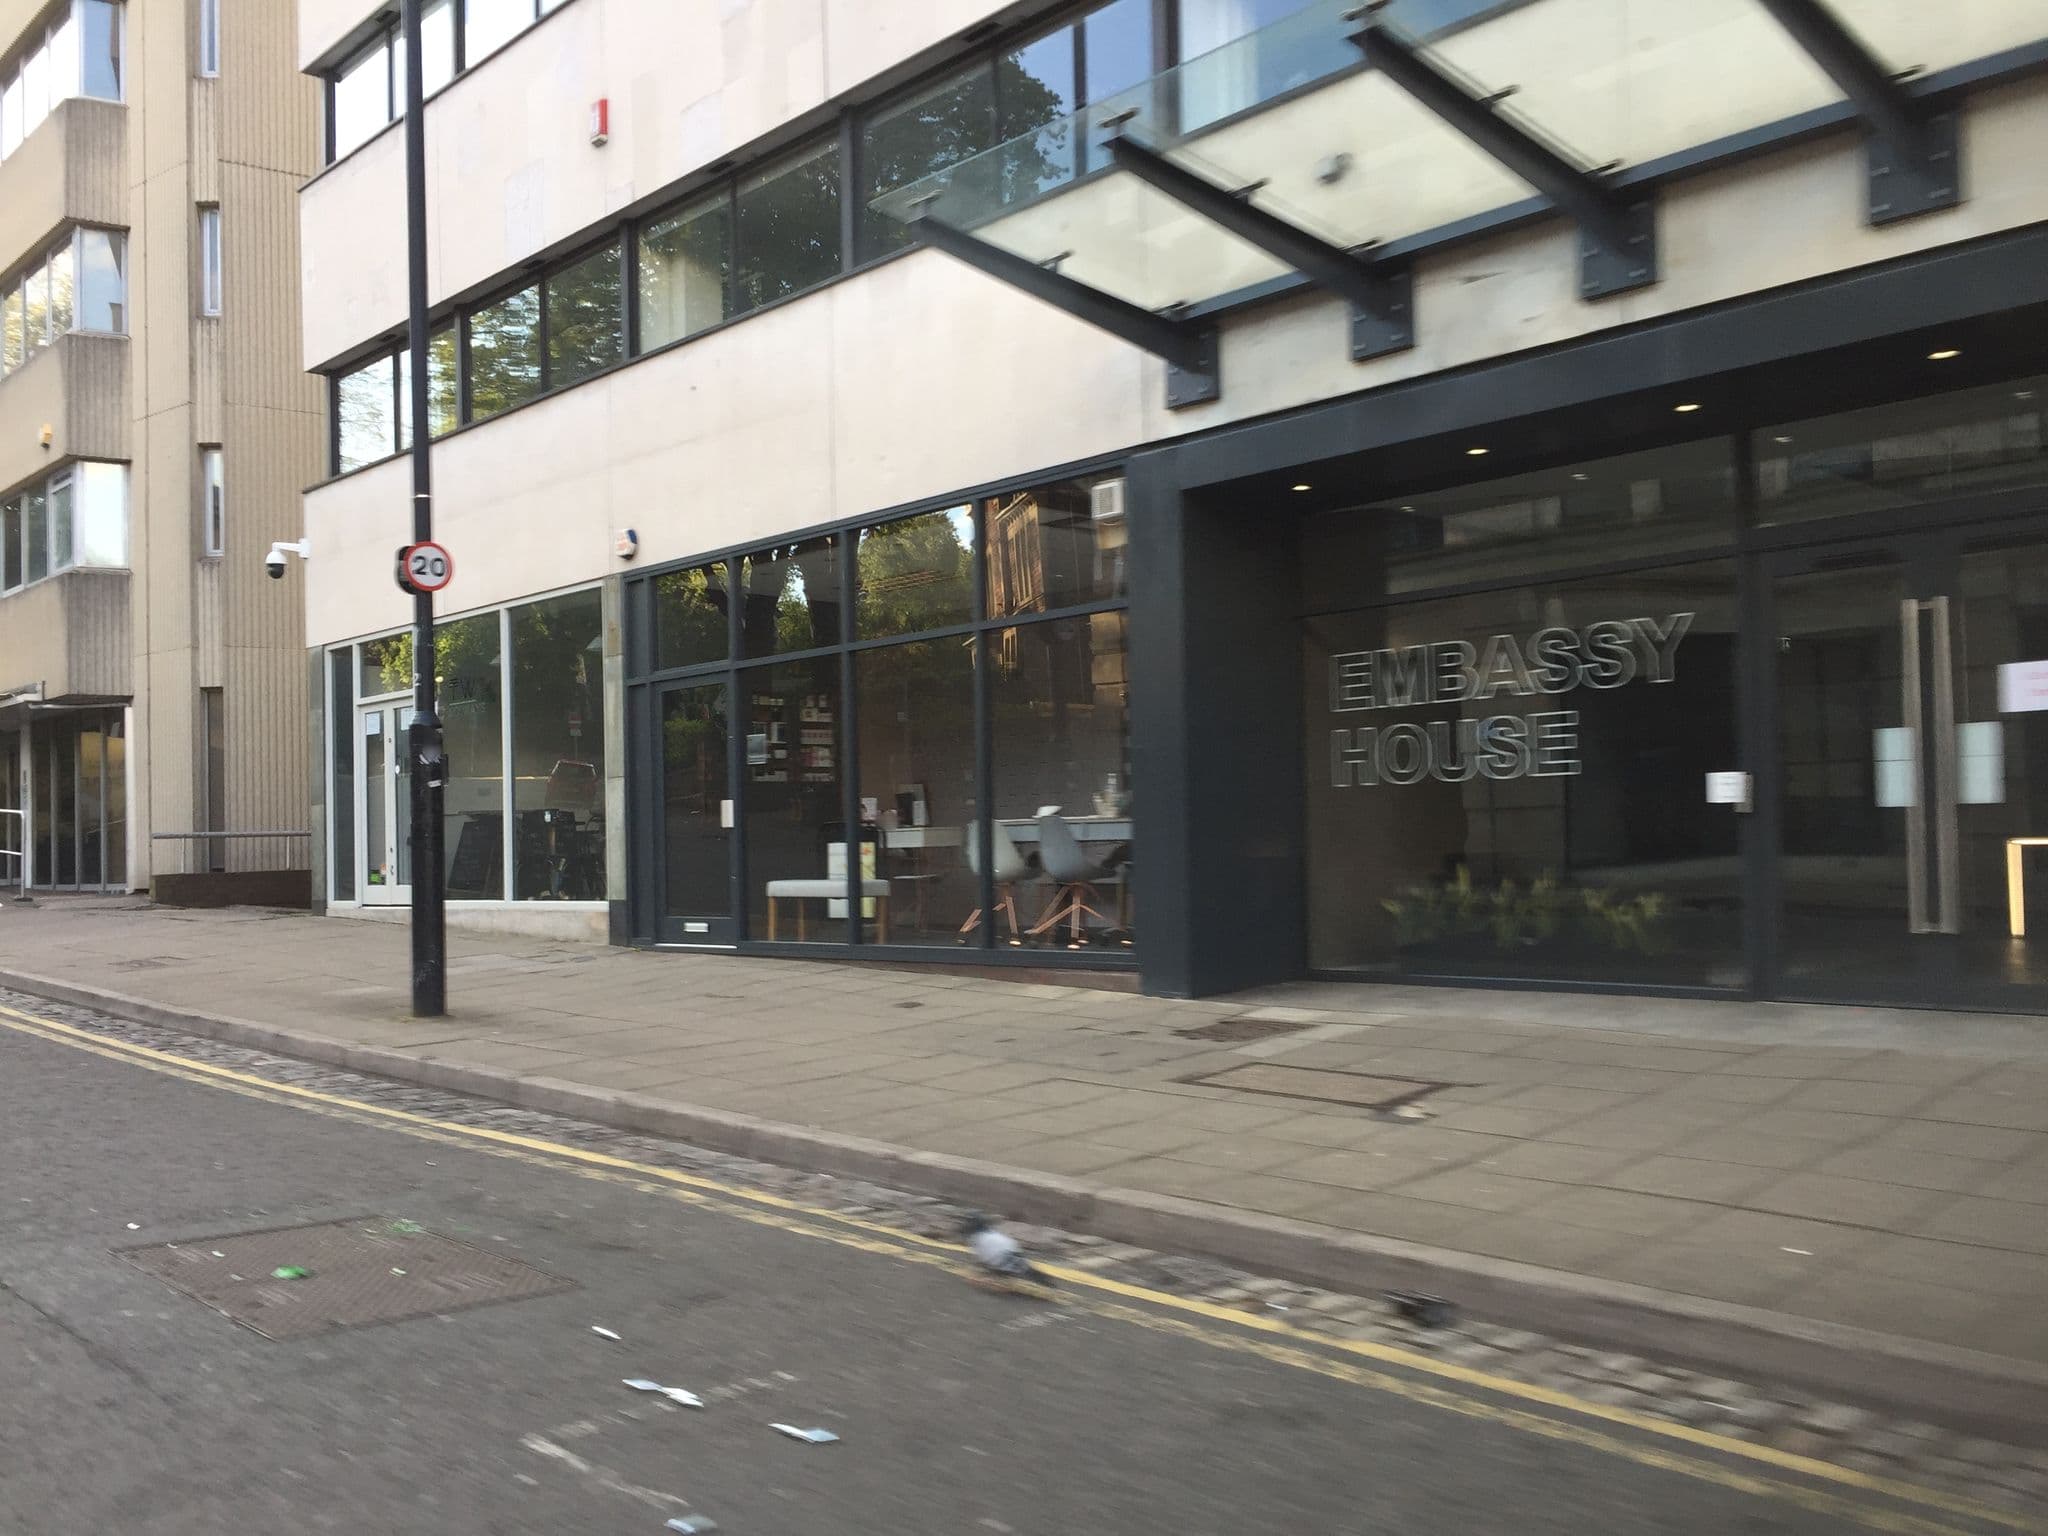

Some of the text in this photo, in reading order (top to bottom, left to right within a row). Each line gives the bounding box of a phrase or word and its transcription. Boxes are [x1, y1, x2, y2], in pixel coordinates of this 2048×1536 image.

[412, 555, 445, 577] 20
[1330, 612, 1696, 712] EMBASSY
[1330, 711, 1582, 787] HOUSE
